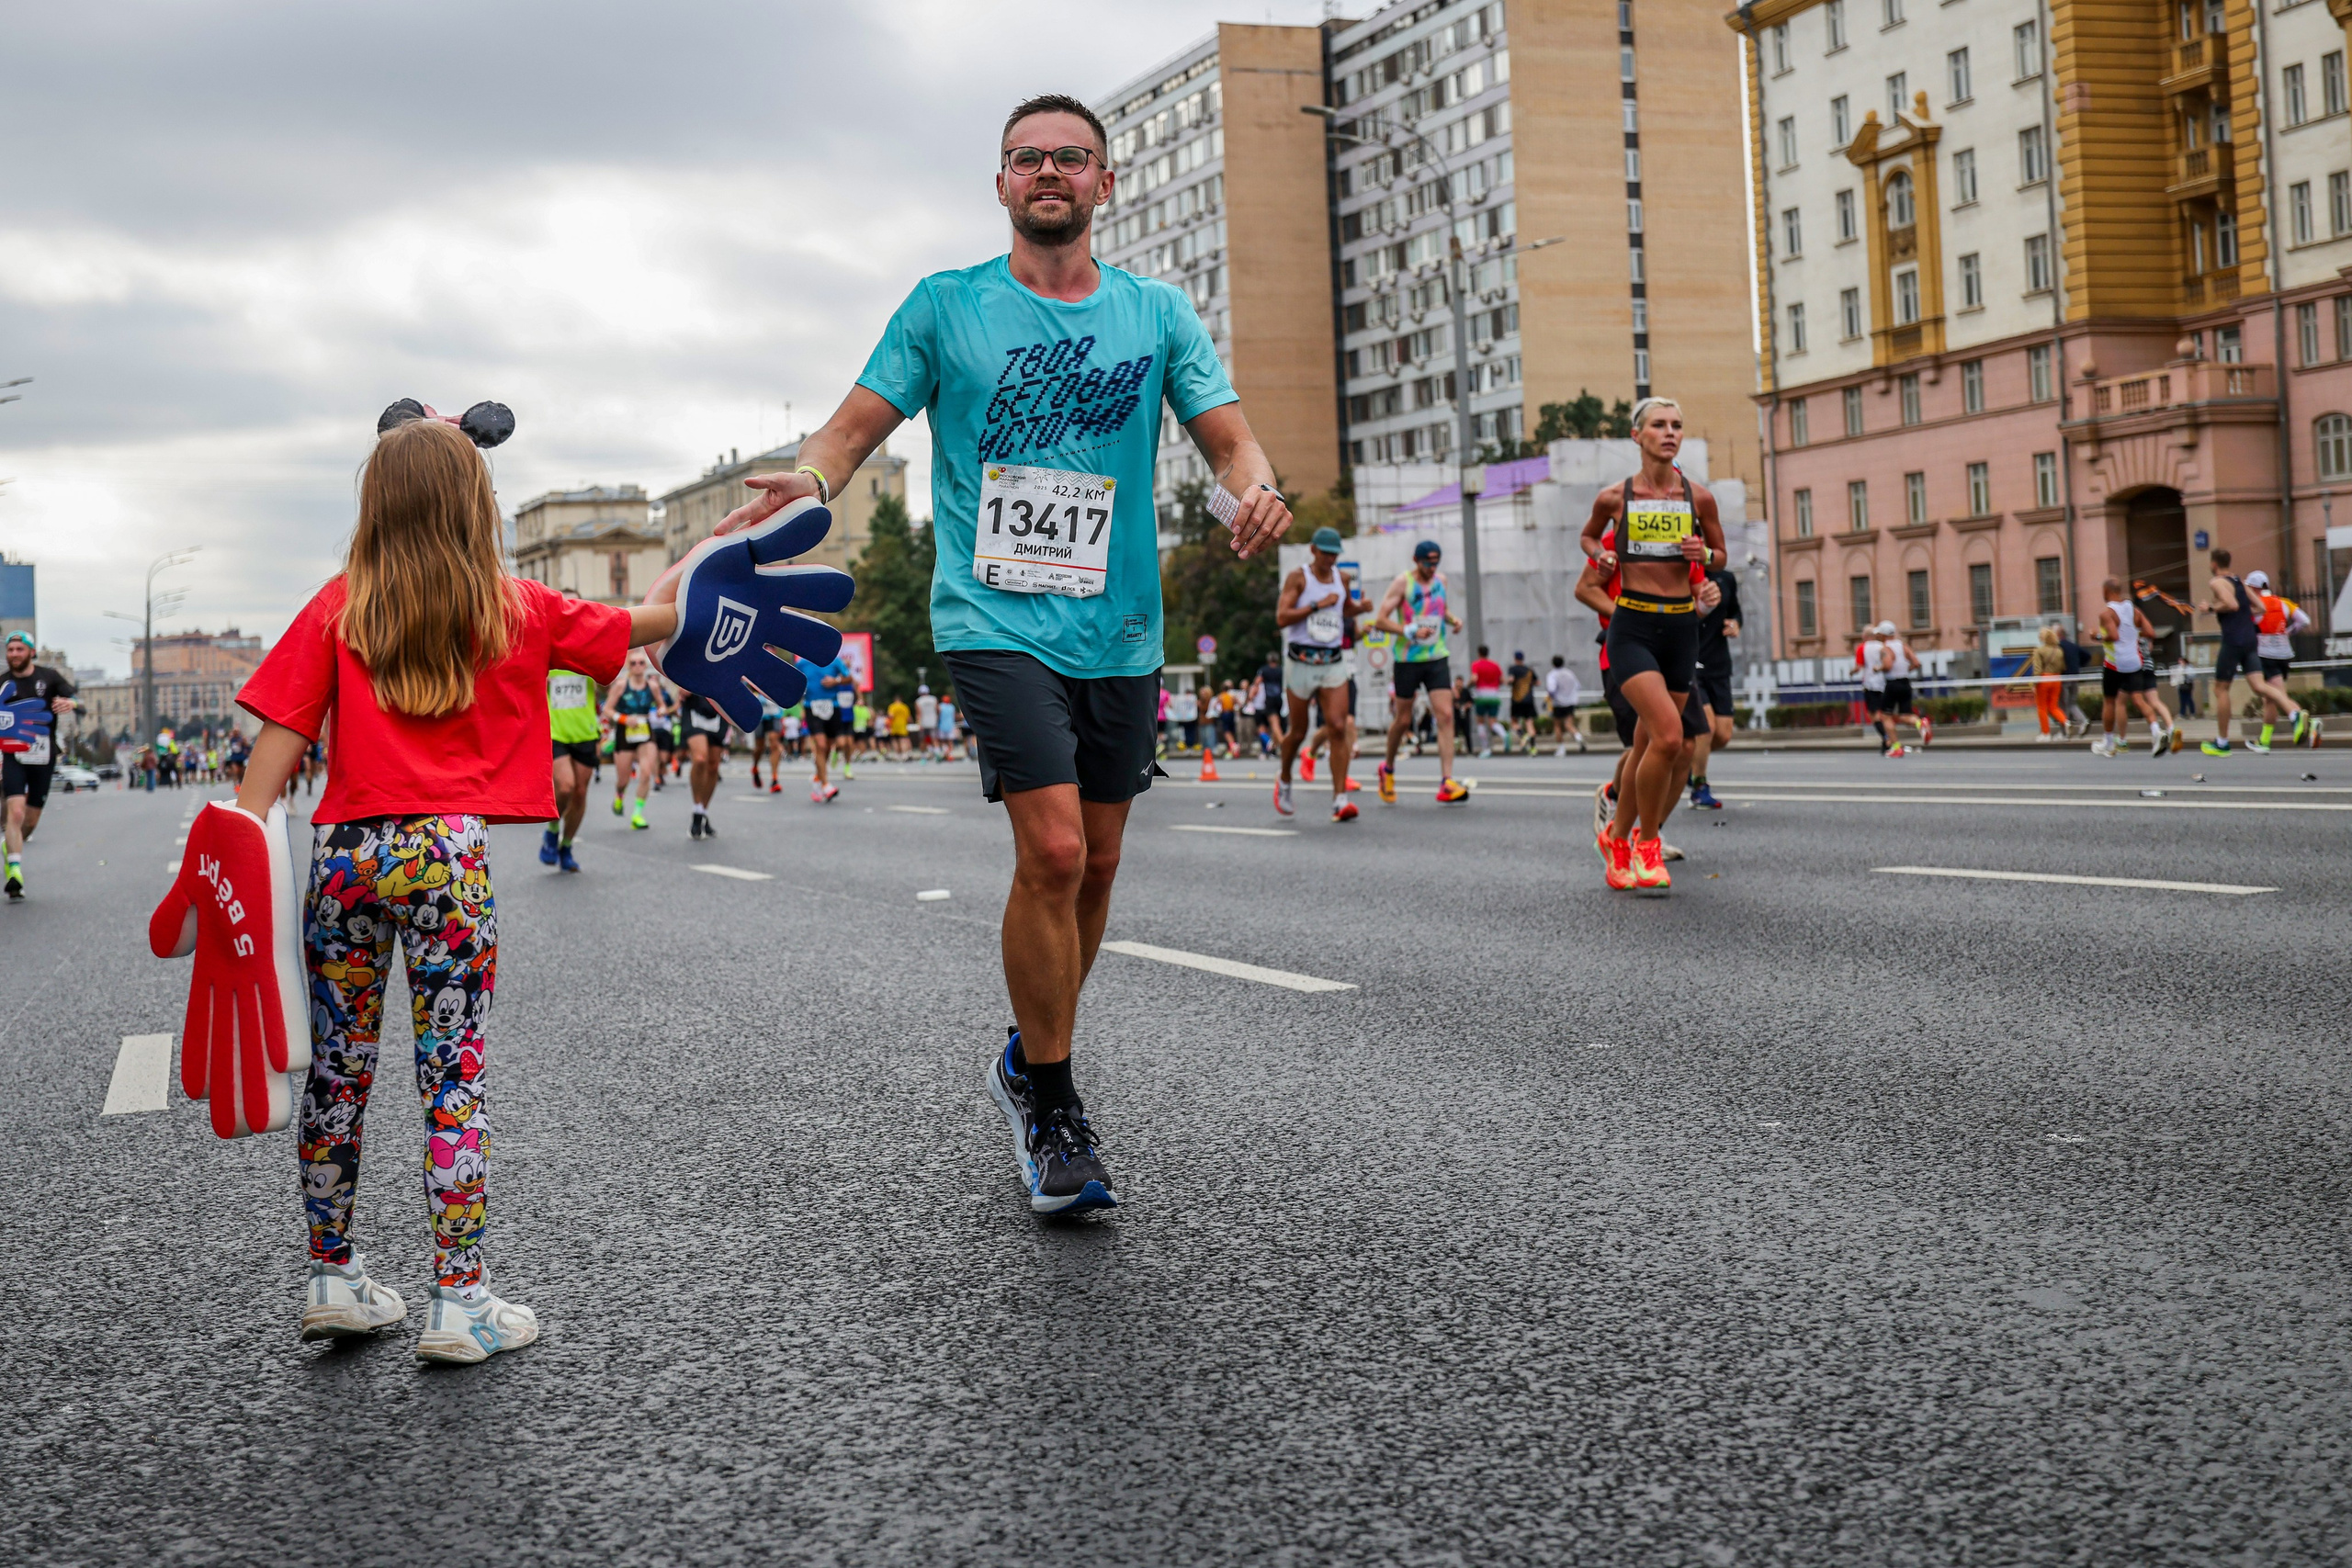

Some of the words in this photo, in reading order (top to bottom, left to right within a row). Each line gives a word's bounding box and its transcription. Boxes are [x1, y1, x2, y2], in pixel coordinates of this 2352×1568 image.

[997, 334, 1096, 385] ТВОЯ
[986, 354, 1153, 424] БЕГОВАЯ
[1052, 485, 1080, 499] 42,2
[987, 497, 1109, 546] 13417
[1637, 514, 1681, 532] 5451
[1013, 543, 1072, 559] ДМИТРИЙ
[1634, 542, 1642, 553] D
[986, 564, 1001, 586] E
[233, 933, 254, 957] 5
